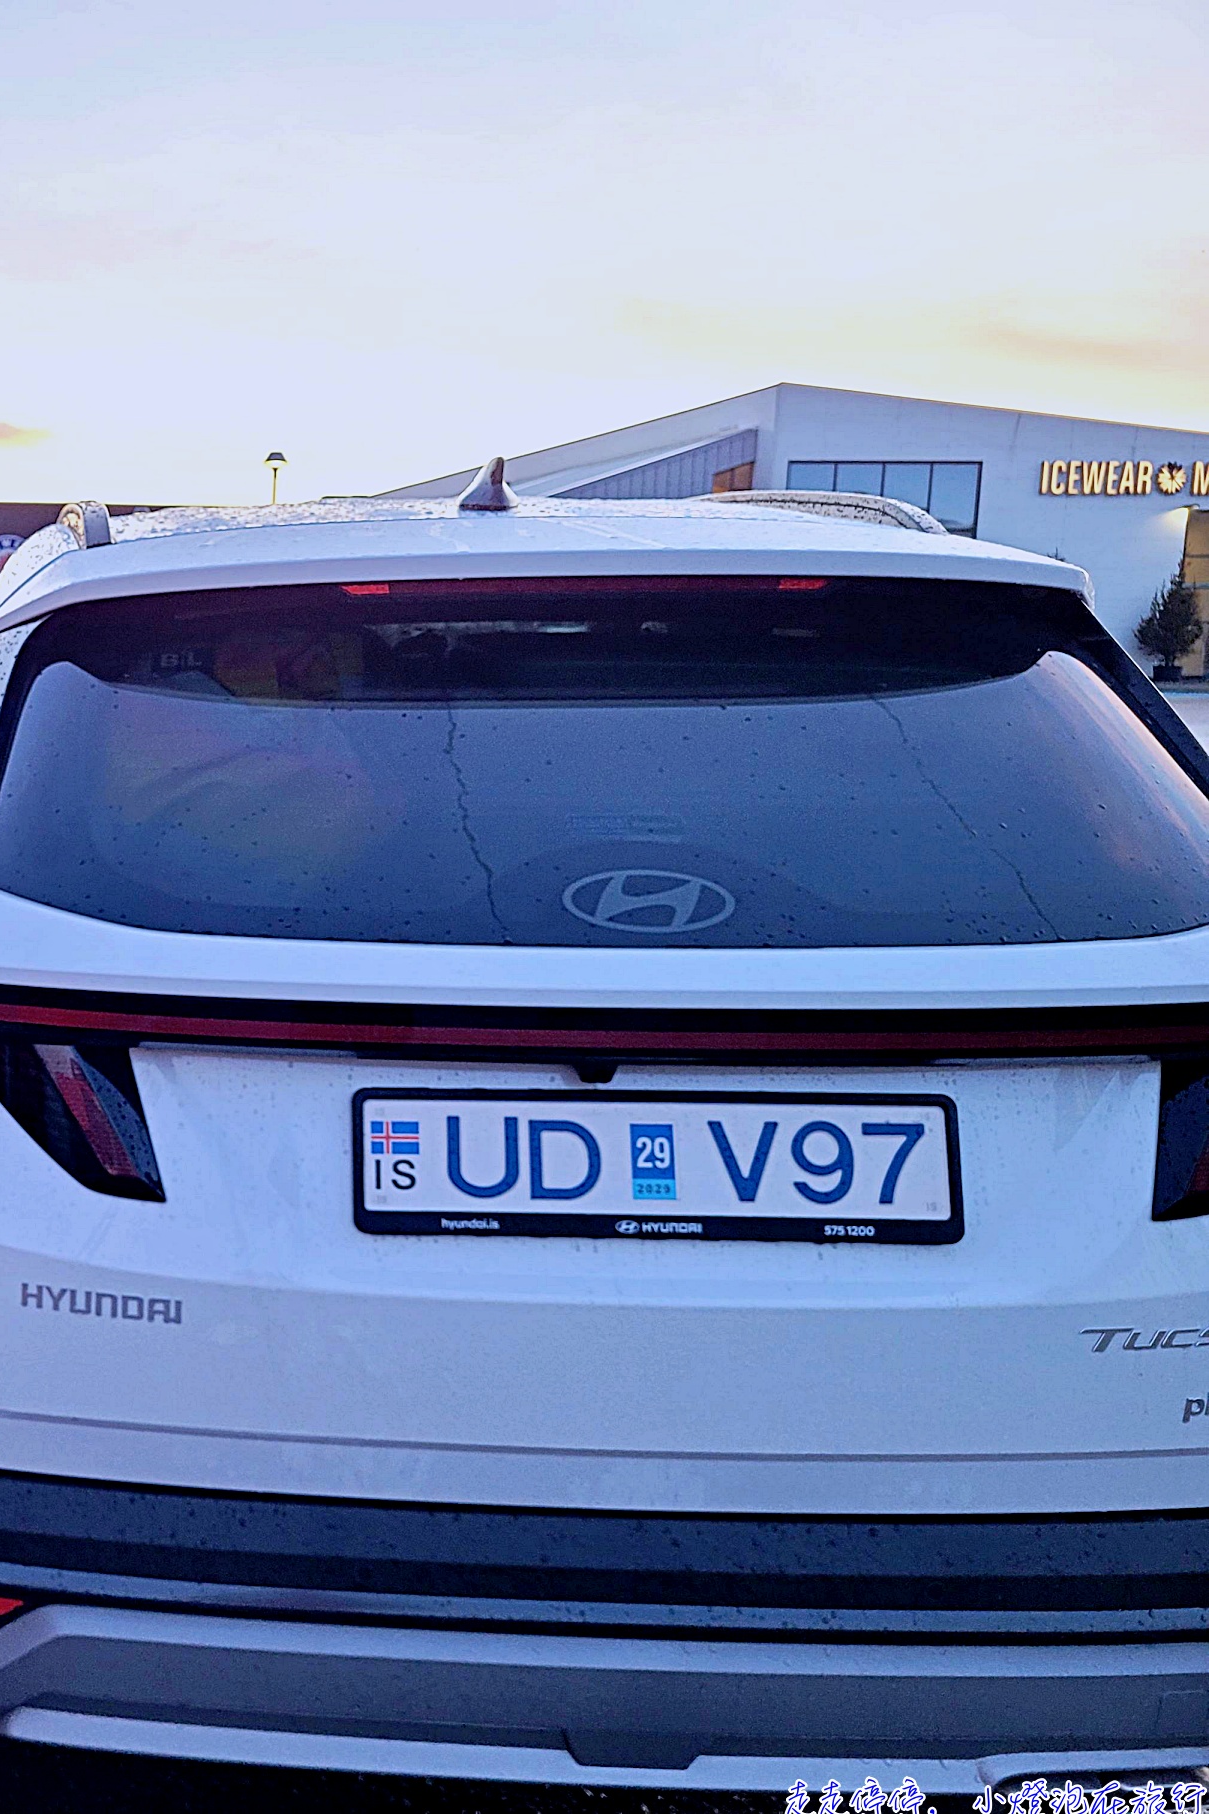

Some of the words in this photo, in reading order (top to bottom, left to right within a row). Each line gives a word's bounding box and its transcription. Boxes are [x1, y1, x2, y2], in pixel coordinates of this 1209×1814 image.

[1040, 460, 1154, 496] ICEWEAR
[446, 1115, 601, 1199] UD
[707, 1120, 925, 1205] V97
[635, 1136, 671, 1169] 29
[375, 1159, 417, 1190] IS
[641, 1222, 703, 1234] HYUNDAI
[21, 1283, 183, 1325] HYUNDAI
